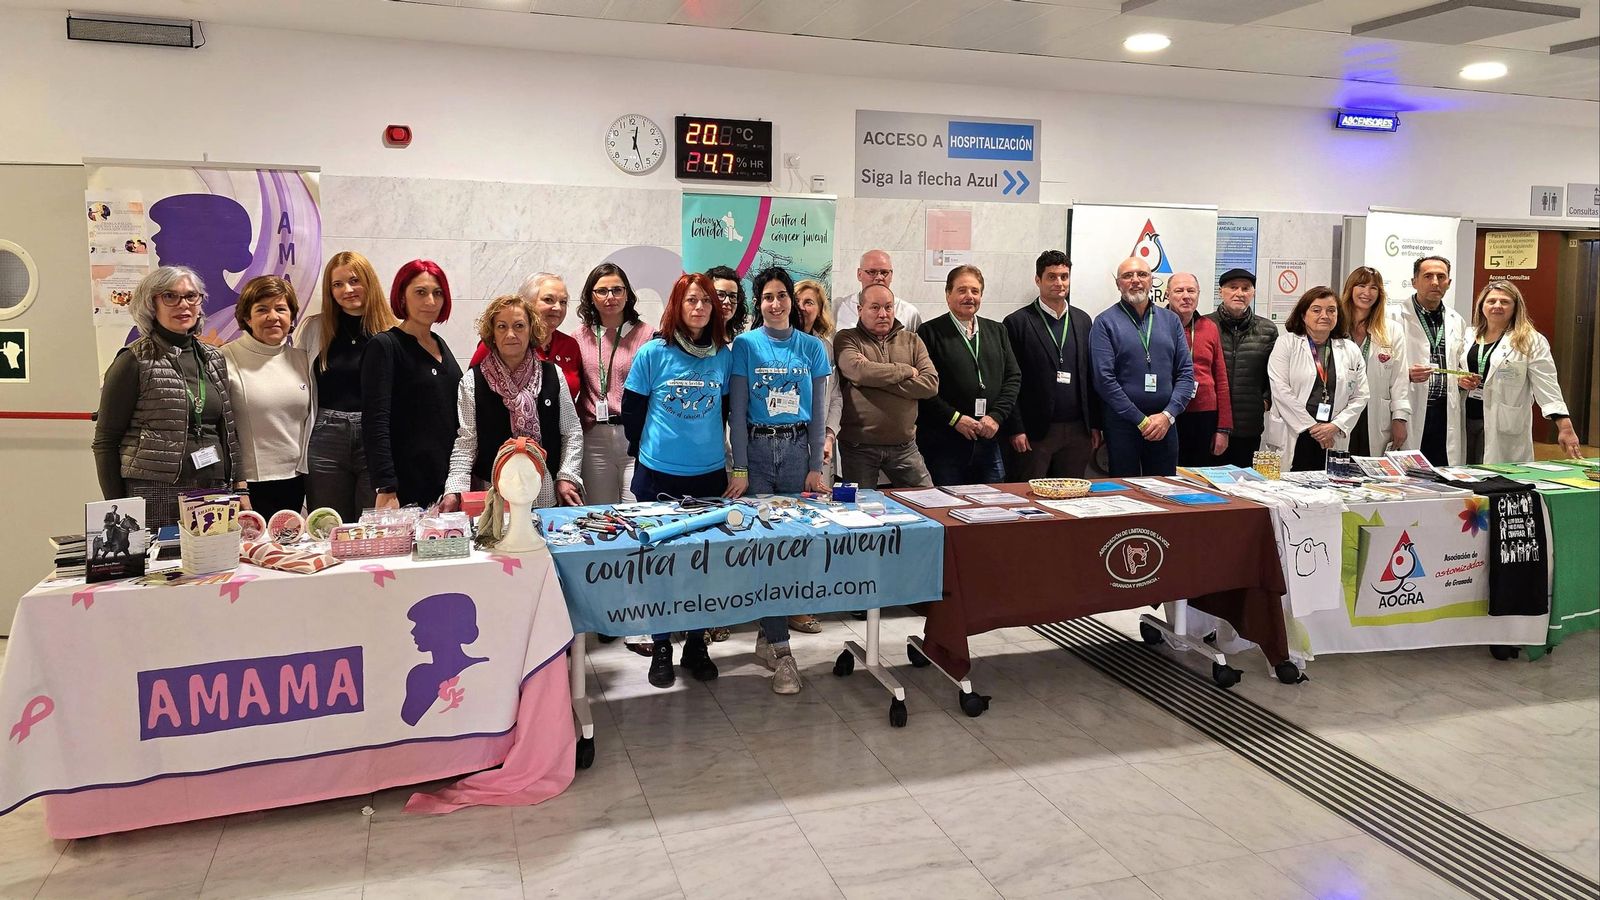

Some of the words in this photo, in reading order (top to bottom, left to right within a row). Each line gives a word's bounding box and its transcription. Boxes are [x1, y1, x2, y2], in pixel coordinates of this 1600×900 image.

[1342, 116, 1393, 128] ASCENSORES
[863, 131, 928, 147] ACCESO
[933, 135, 943, 148] A
[950, 136, 1032, 151] HOSPITALIZACIÓN
[687, 151, 734, 174] 24.7
[750, 160, 764, 168] HR
[861, 169, 893, 187] Siga
[900, 170, 912, 185] la
[918, 171, 961, 187] flecha
[967, 173, 998, 187] Azul
[800, 212, 807, 227] el
[1569, 207, 1598, 215] Consultas
[803, 229, 828, 246] juvenil
[585, 545, 676, 585] contra
[691, 539, 710, 573] el
[725, 536, 813, 569] cáncer
[824, 525, 902, 573] juvenil
[1444, 552, 1470, 561] Asociación
[1453, 577, 1472, 586] Granada
[607, 577, 877, 623] www.relevosxlavida.com
[1378, 592, 1425, 609] AOGRA
[148, 659, 358, 729] AMAMA
